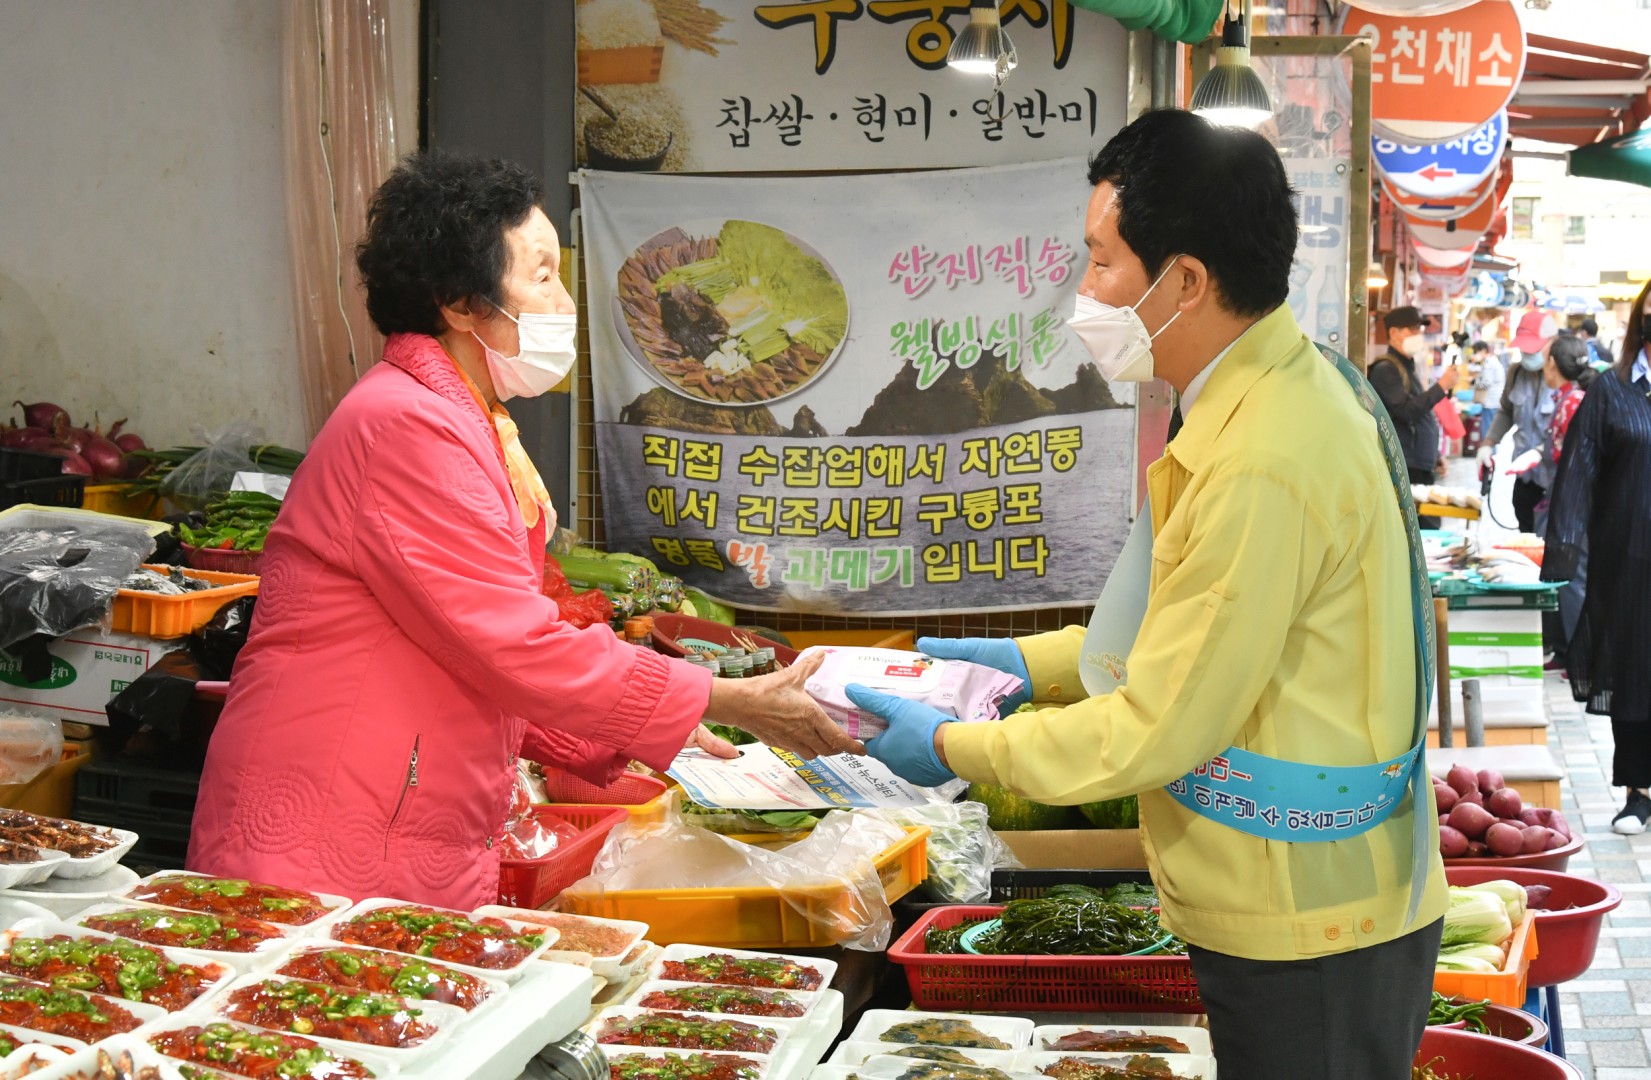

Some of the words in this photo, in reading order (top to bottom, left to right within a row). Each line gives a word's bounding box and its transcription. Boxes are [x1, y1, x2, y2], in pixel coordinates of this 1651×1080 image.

[715, 93, 814, 148] 찹쌀
[852, 91, 932, 142] 현미
[972, 86, 1098, 142] 일반미
[887, 235, 1075, 297] 산지직송
[889, 308, 1064, 388] 웰빙식품
[642, 434, 722, 481] 직접
[738, 442, 946, 489] 수잡업해서
[961, 426, 1083, 480] 자연풍
[647, 487, 719, 529] 에서
[735, 492, 902, 540] 건조시킨
[917, 482, 1044, 536] 구룡포
[650, 536, 725, 573] 명품
[725, 538, 770, 589] 발
[781, 543, 915, 591] 과메기
[921, 536, 1050, 584] 입니다
[1194, 784, 1257, 819] 이겨낼
[1258, 807, 1283, 827] 수
